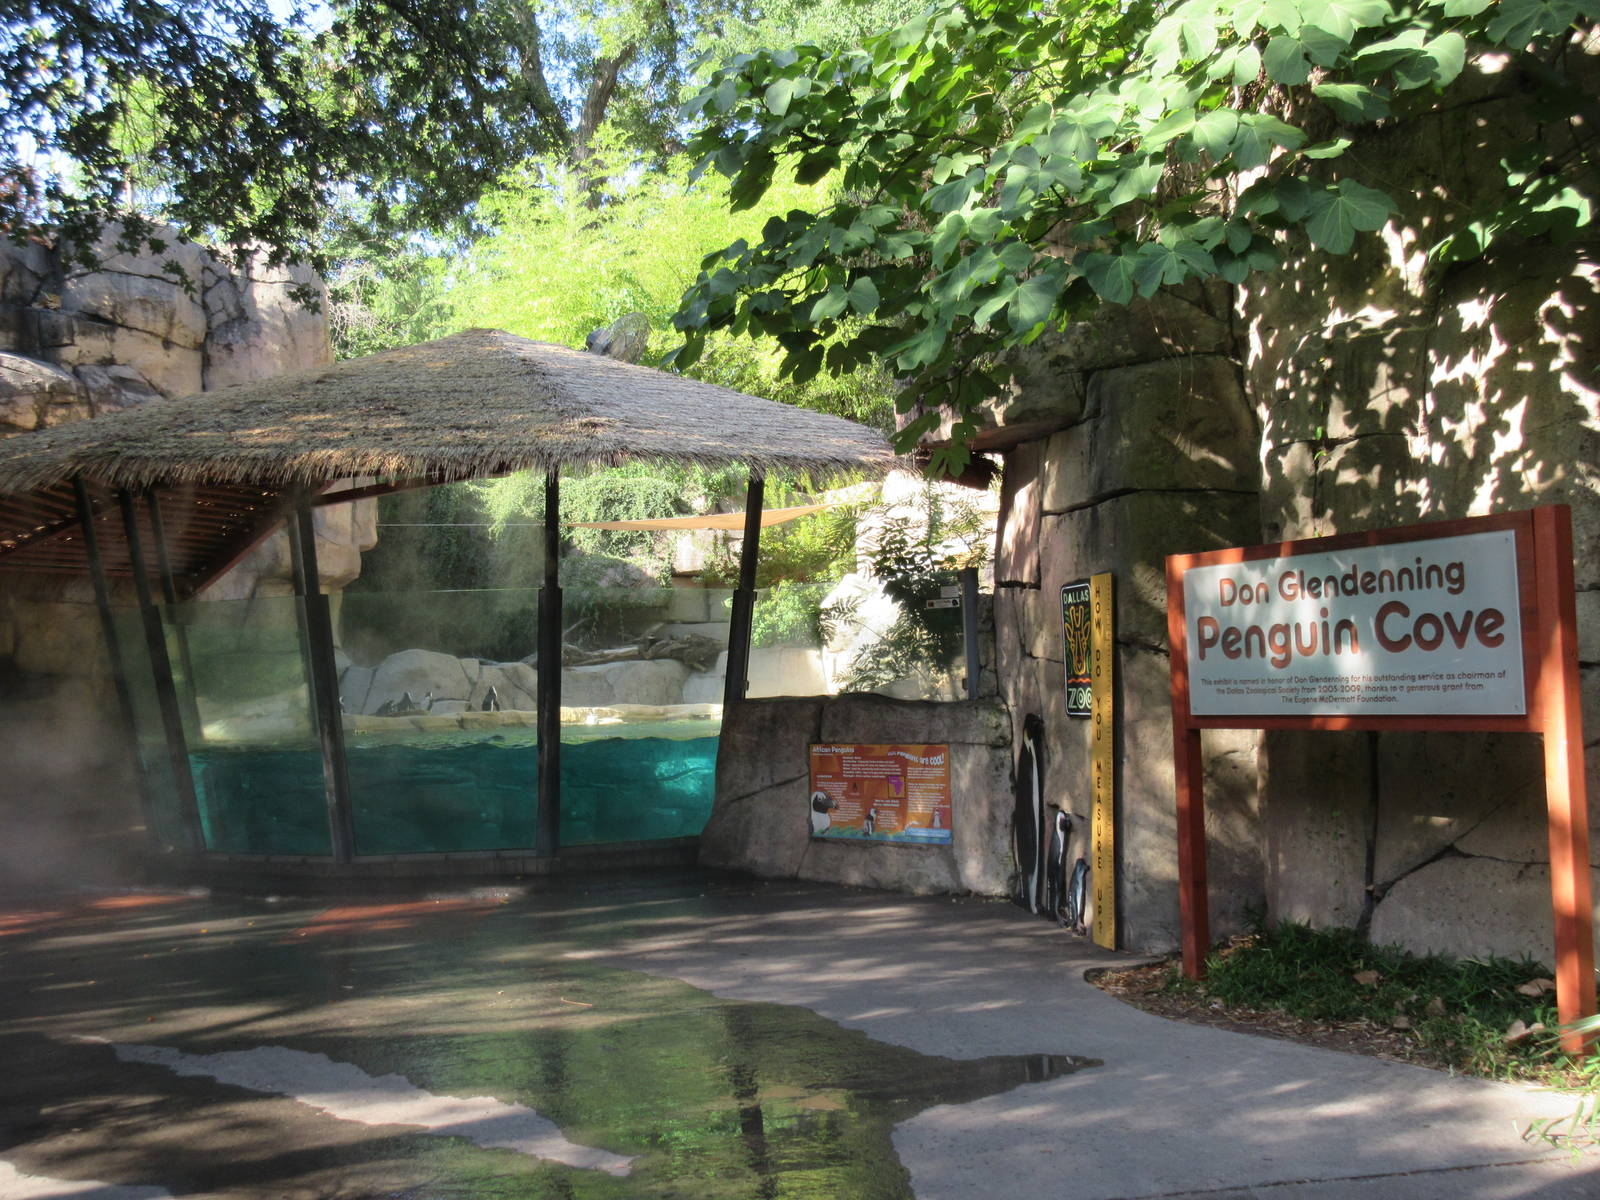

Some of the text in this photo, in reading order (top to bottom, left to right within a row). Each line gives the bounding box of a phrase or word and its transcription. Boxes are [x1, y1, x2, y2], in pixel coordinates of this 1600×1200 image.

[1219, 556, 1465, 607] Don Glendenning
[1063, 589, 1089, 605] DALLAS
[1196, 600, 1505, 669] Penguin Cove
[1095, 649, 1102, 677] DO
[1200, 678, 1212, 686] This
[1213, 678, 1233, 686] exhibit
[1267, 676, 1285, 684] honor
[1286, 675, 1294, 684] of
[1295, 675, 1307, 684] Don
[1309, 675, 1350, 684] Glendenning
[1351, 674, 1361, 683] for
[1362, 673, 1373, 682] his
[1374, 672, 1416, 682] outstanding
[1417, 672, 1444, 681] service
[1457, 671, 1496, 680] chairman
[1497, 670, 1506, 679] of
[1226, 686, 1245, 695] Dallas
[1245, 686, 1277, 695] Zoological
[1278, 686, 1300, 695] Society
[1301, 685, 1316, 694] from
[1365, 684, 1388, 692] thanks
[1389, 684, 1398, 692] to
[1406, 684, 1440, 693] generous
[1442, 683, 1463, 692] grant
[1465, 682, 1484, 690] from
[1068, 687, 1092, 709] ZOO
[1281, 693, 1398, 704] The Eugene McDermott Foundation.
[831, 746, 855, 754] Penguins
